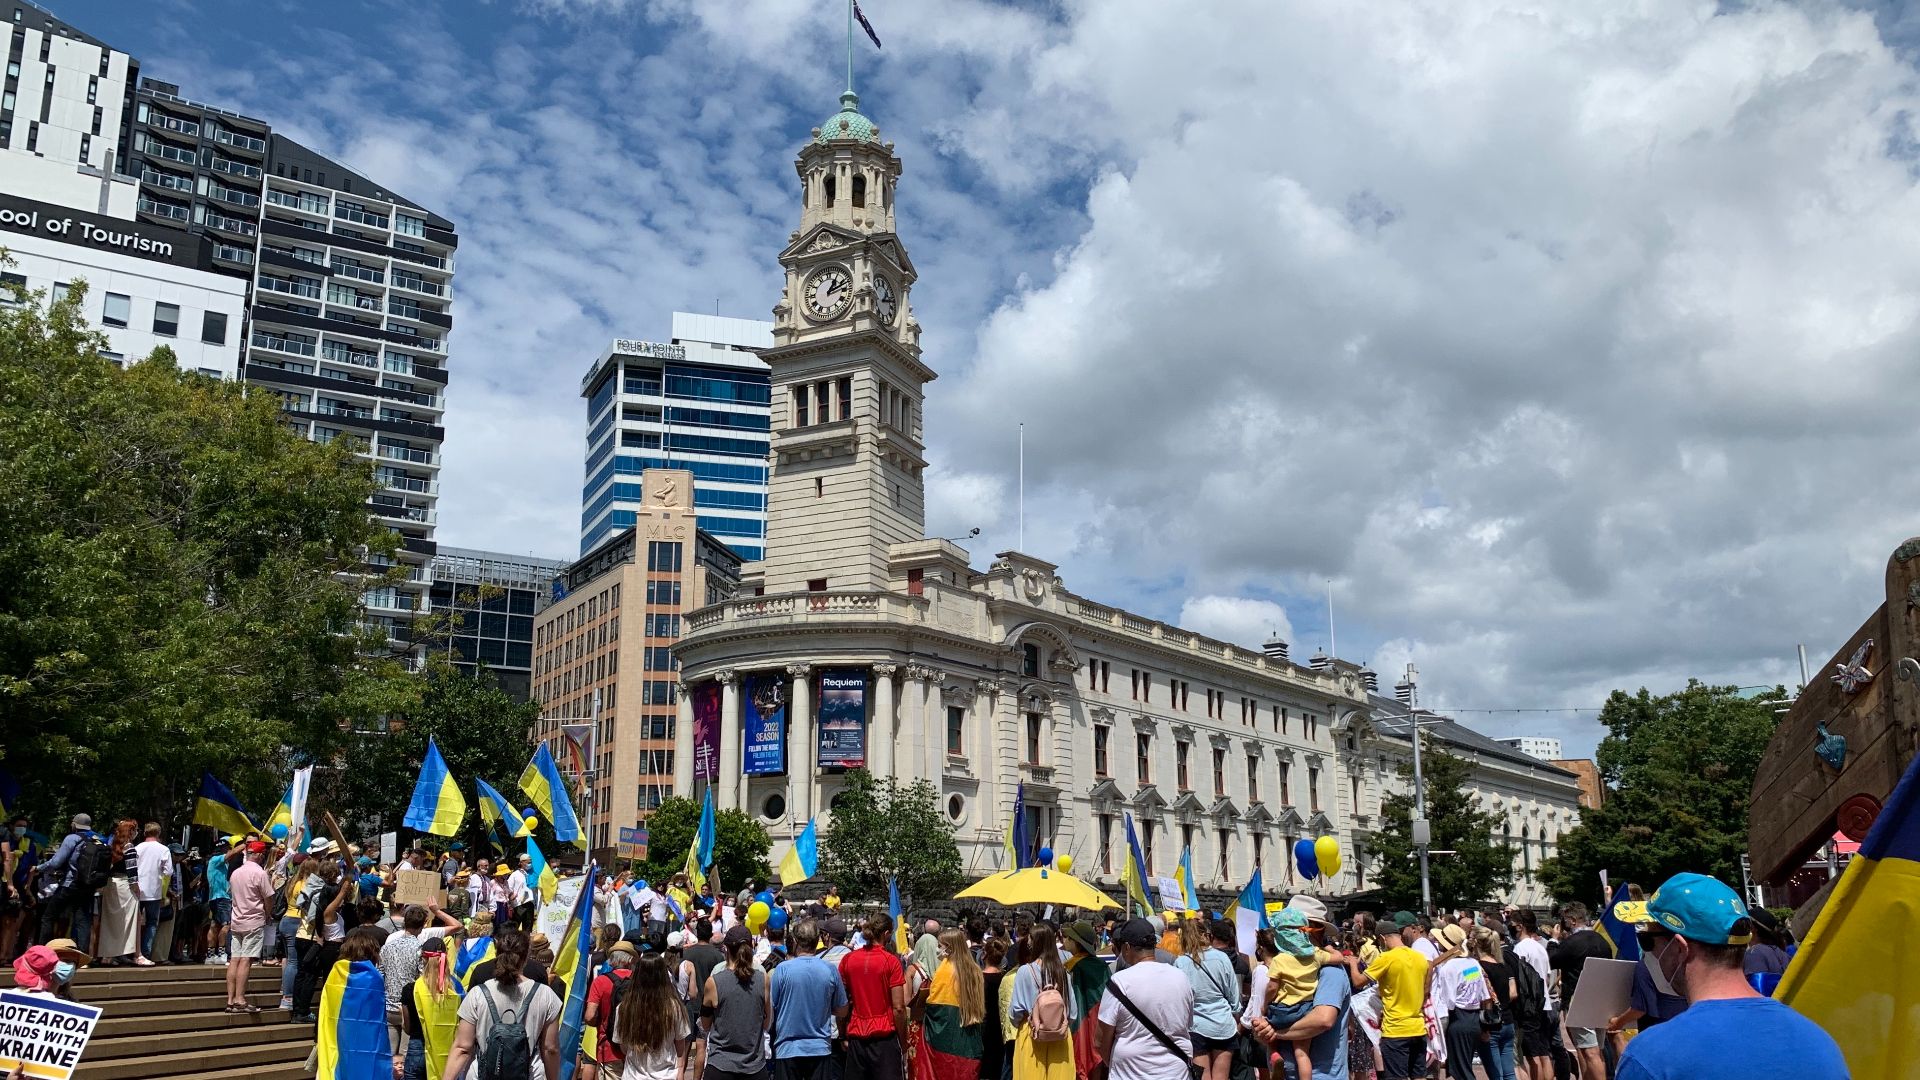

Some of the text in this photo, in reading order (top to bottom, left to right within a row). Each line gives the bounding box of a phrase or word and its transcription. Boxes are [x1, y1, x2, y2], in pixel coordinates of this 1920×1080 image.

[46, 218, 72, 235] of
[80, 221, 172, 256] Tourism
[652, 343, 686, 355] POINTS
[646, 524, 686, 540] MLC
[823, 678, 863, 688] Requiem
[763, 722, 779, 732] 2022
[755, 731, 779, 742] SEASON
[400, 872, 433, 886] CUT
[43, 1030, 85, 1049] WITH
[0, 1038, 79, 1068] KRAINE
